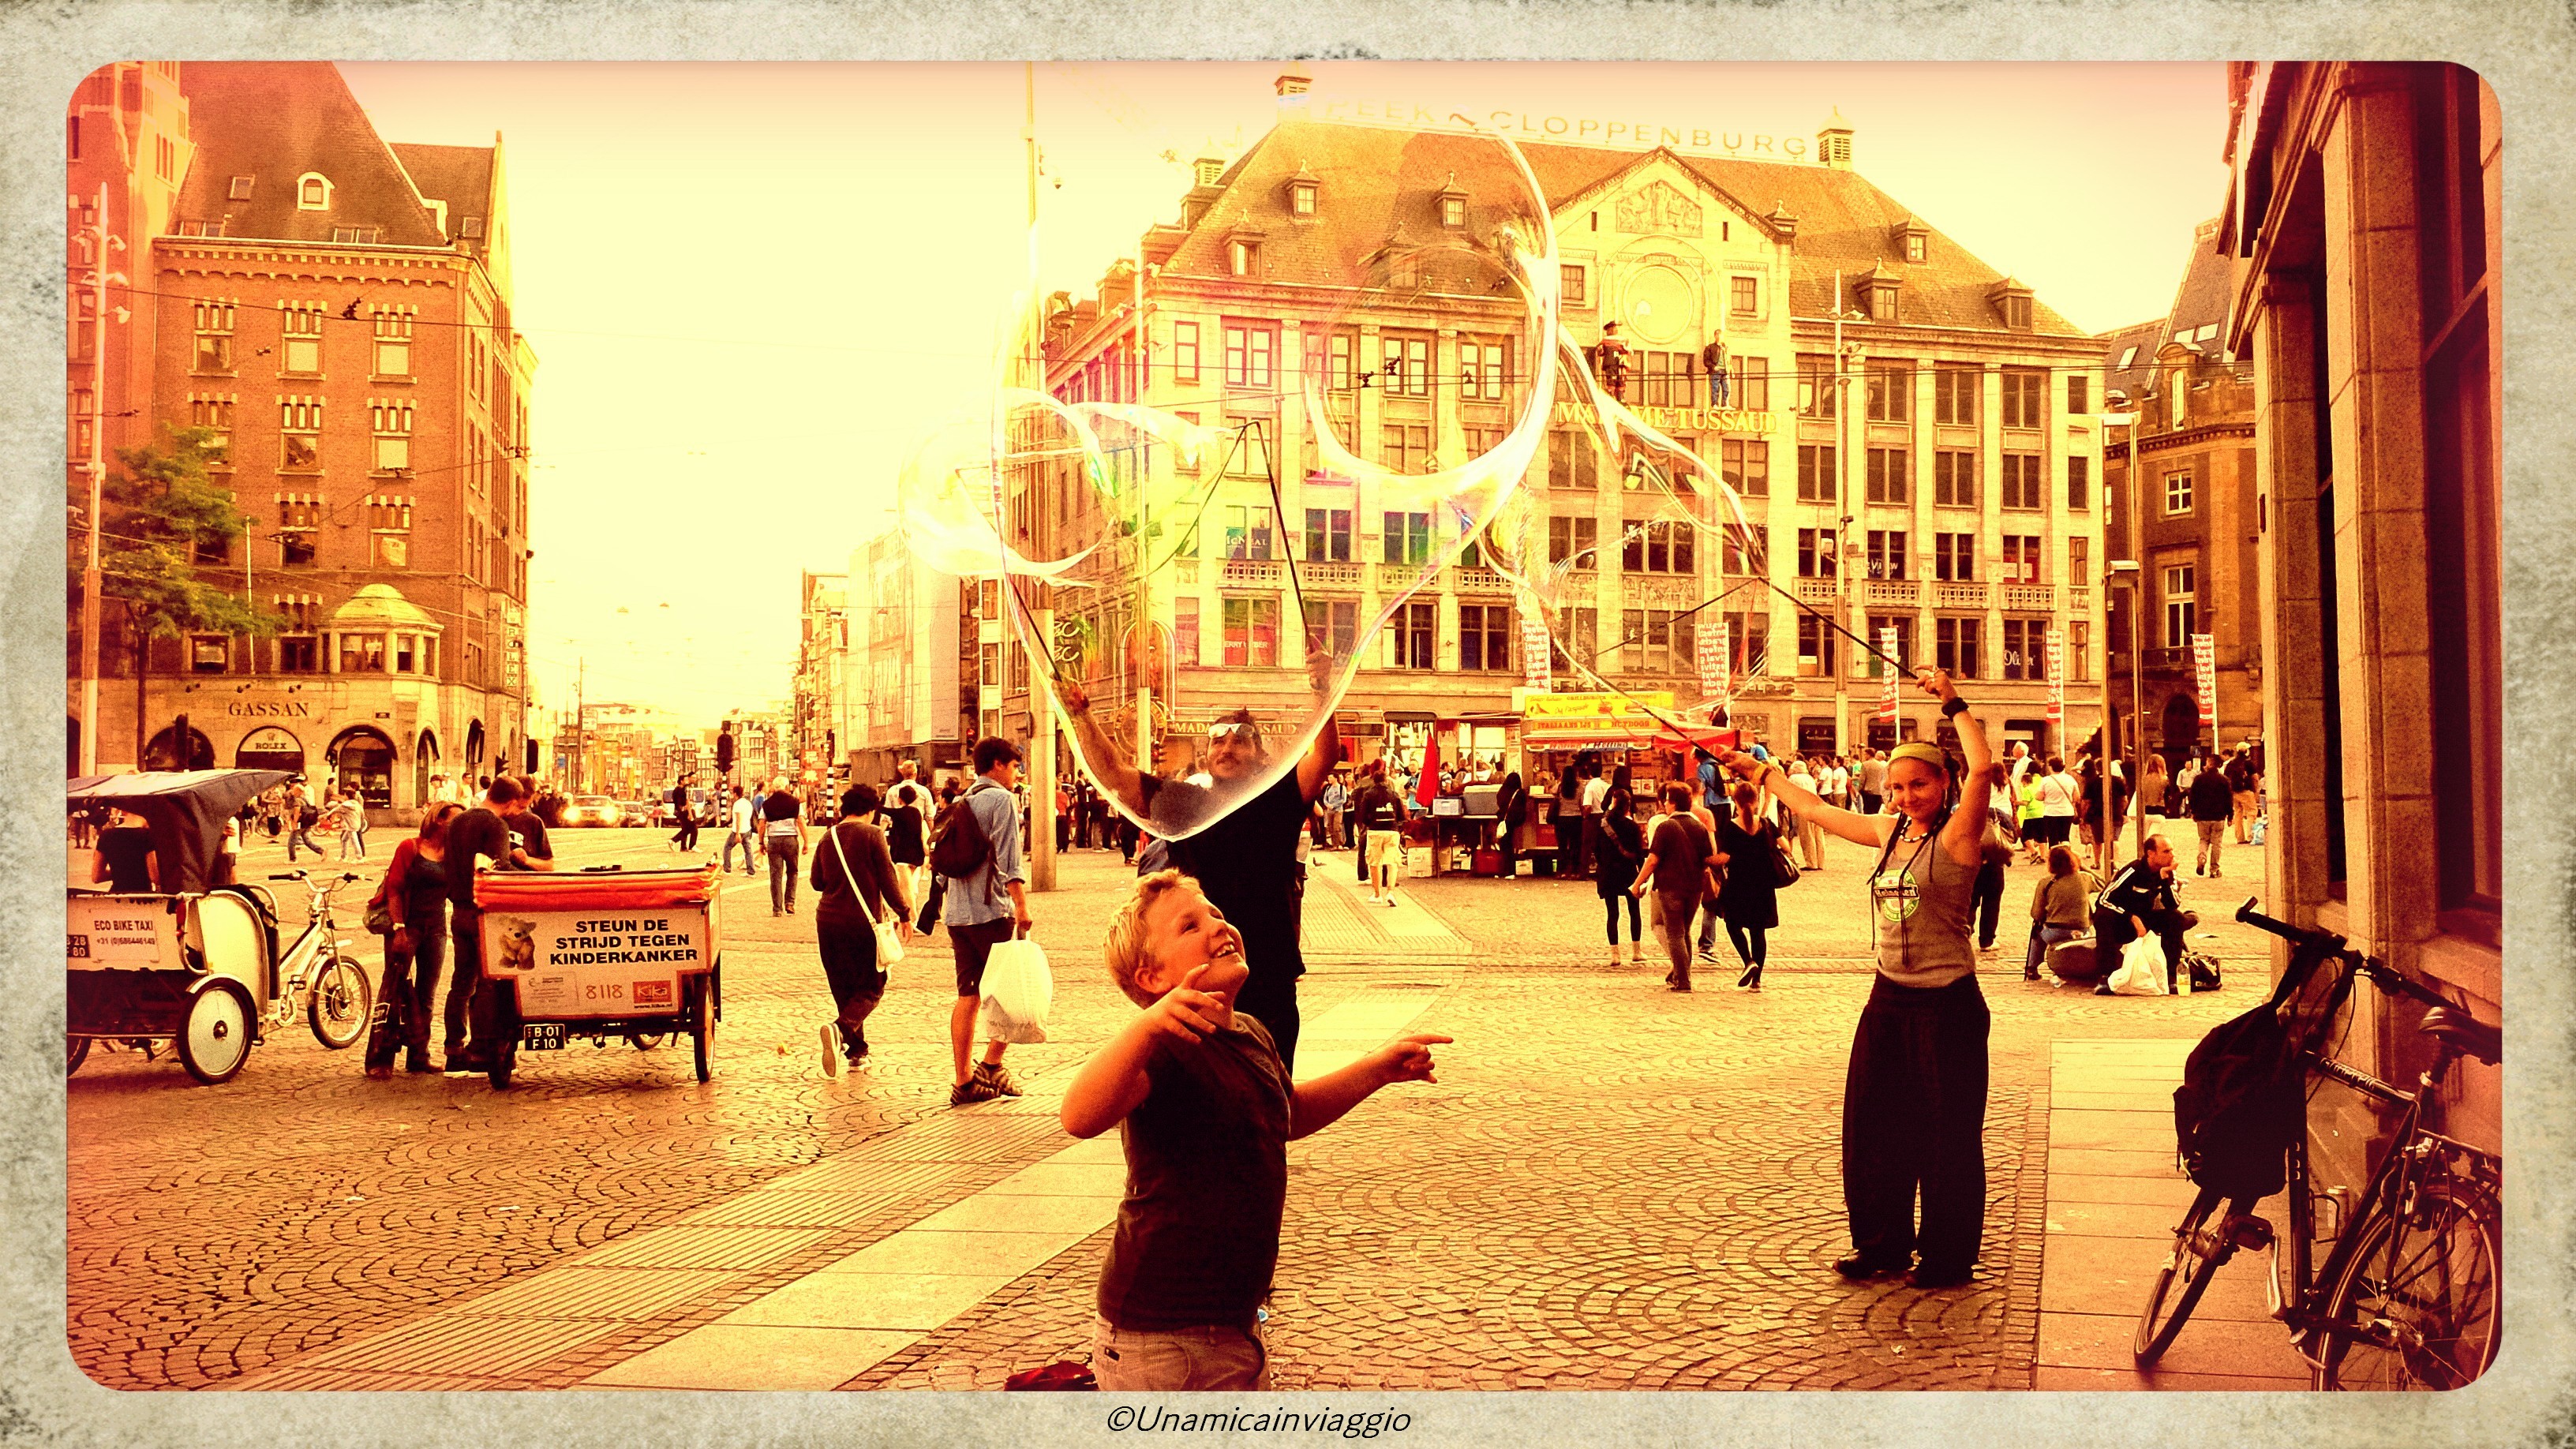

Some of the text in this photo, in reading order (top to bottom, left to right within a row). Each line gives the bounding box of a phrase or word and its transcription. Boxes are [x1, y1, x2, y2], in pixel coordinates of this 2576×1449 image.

[1325, 95, 1807, 155] PEEK CLOPPENBURG
[1556, 401, 1782, 433] MAME TUSSAUD
[229, 702, 309, 717] GASSAN
[94, 920, 153, 930] ECO BIKE TAXI
[575, 919, 668, 933] STEUN DE
[556, 934, 690, 949] STRIJD TEGEN
[550, 949, 698, 965] KINDERKANKER
[586, 984, 623, 999] 8118
[532, 1039, 557, 1050] F 10
